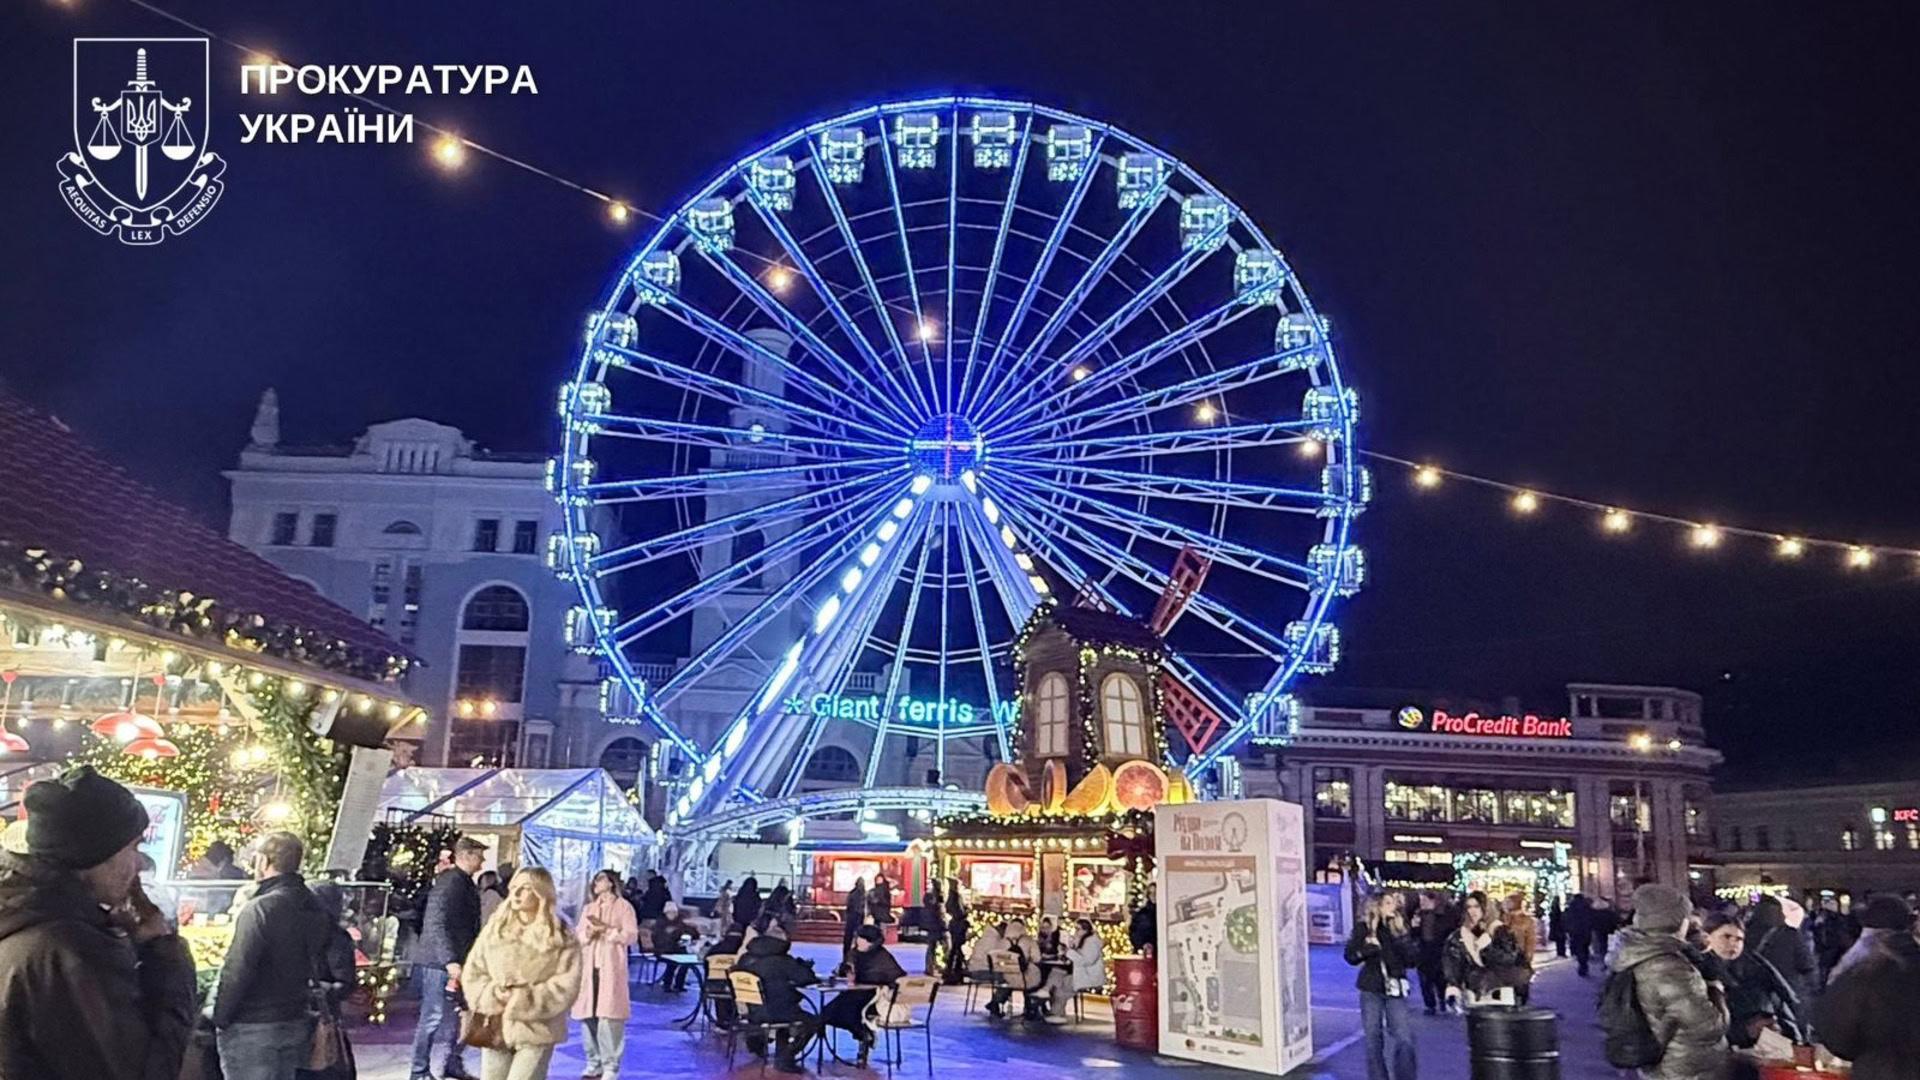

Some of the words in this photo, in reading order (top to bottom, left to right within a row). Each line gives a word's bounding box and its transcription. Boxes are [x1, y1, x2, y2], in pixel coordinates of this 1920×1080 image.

[811, 693, 879, 719] Giant
[899, 695, 974, 722] ferris
[1432, 710, 1519, 735] ProCredit
[1523, 715, 1572, 736] Bank
[1894, 809, 1919, 822] KFC
